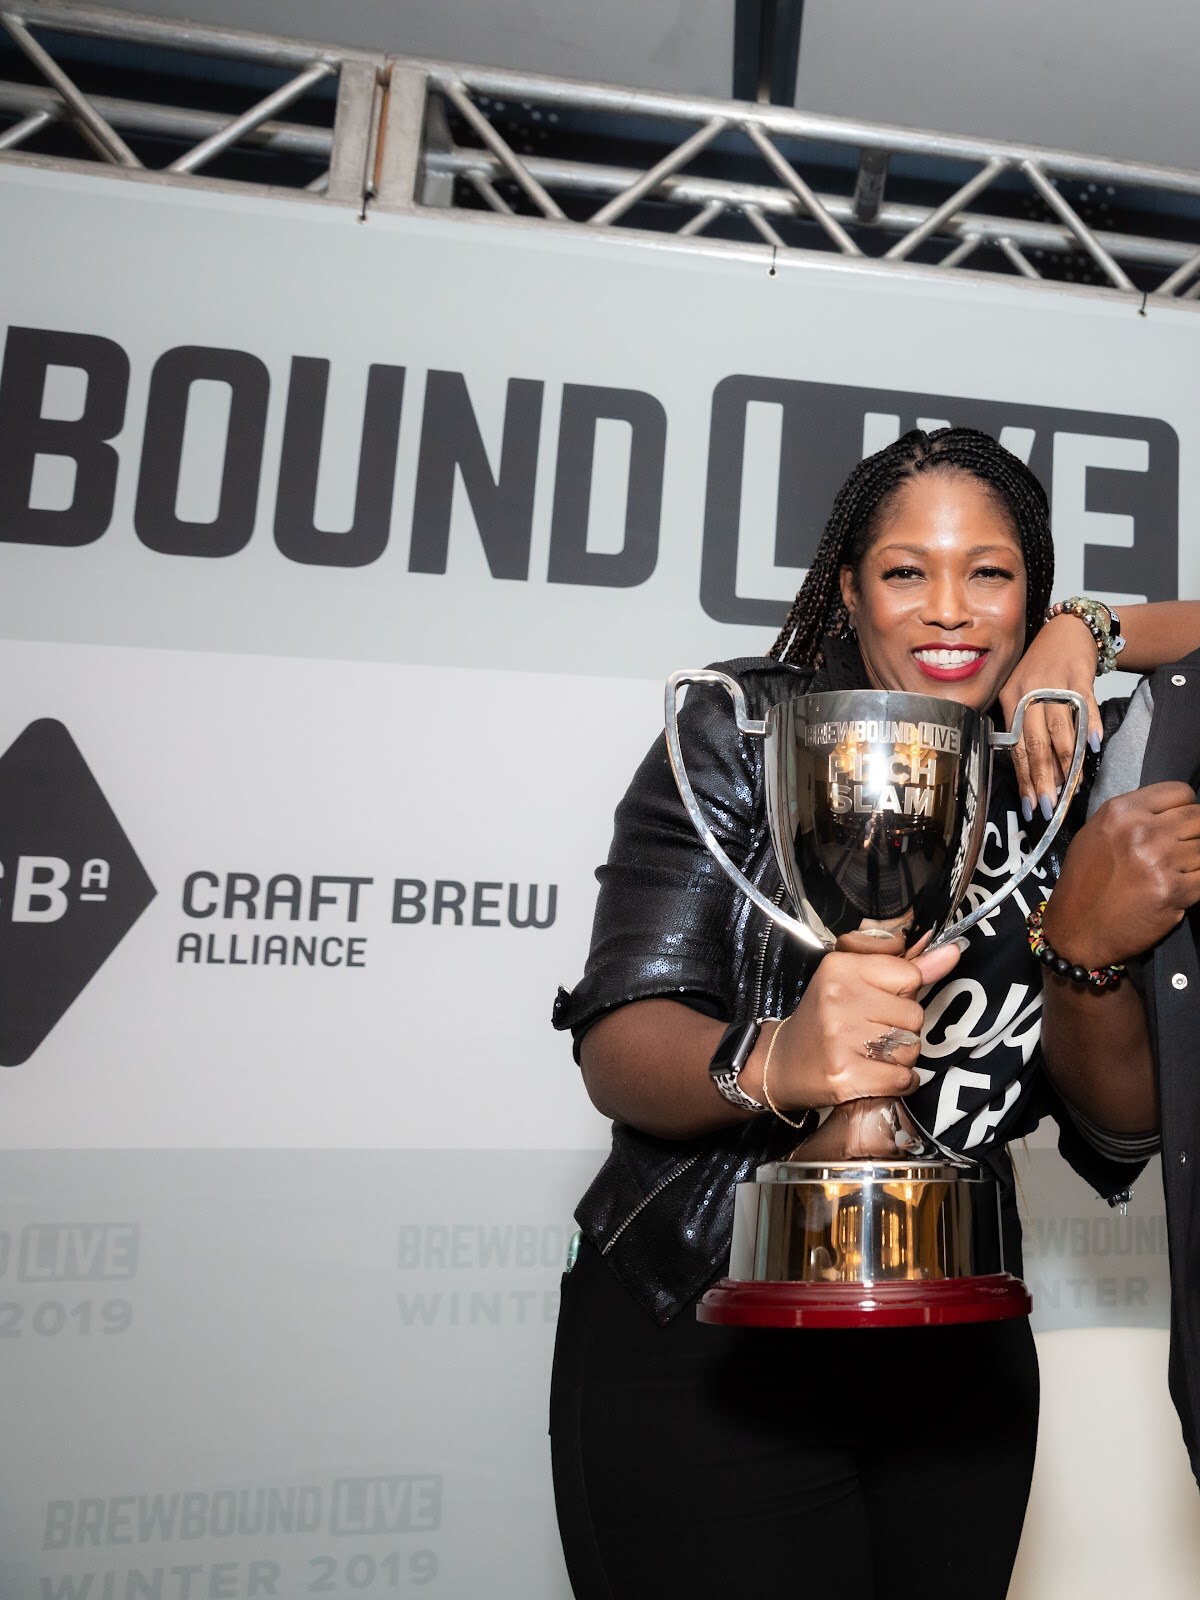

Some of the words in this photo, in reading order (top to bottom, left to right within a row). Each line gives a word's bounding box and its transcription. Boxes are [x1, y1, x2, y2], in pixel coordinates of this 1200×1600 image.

[805, 720, 918, 746] BREWBOUND
[919, 722, 961, 755] LIVE
[829, 782, 936, 818] SLAM
[182, 870, 374, 922] CRAFT
[391, 877, 559, 929] BREW
[176, 932, 367, 967] ALLIANCE
[21, 1226, 136, 1279] LIVE
[0, 1299, 133, 1338] 2019
[42, 1485, 323, 1550] BREWBOUND
[334, 1477, 439, 1533] LIVE
[39, 1559, 280, 1600] WINTER
[308, 1549, 438, 1592] 2019
